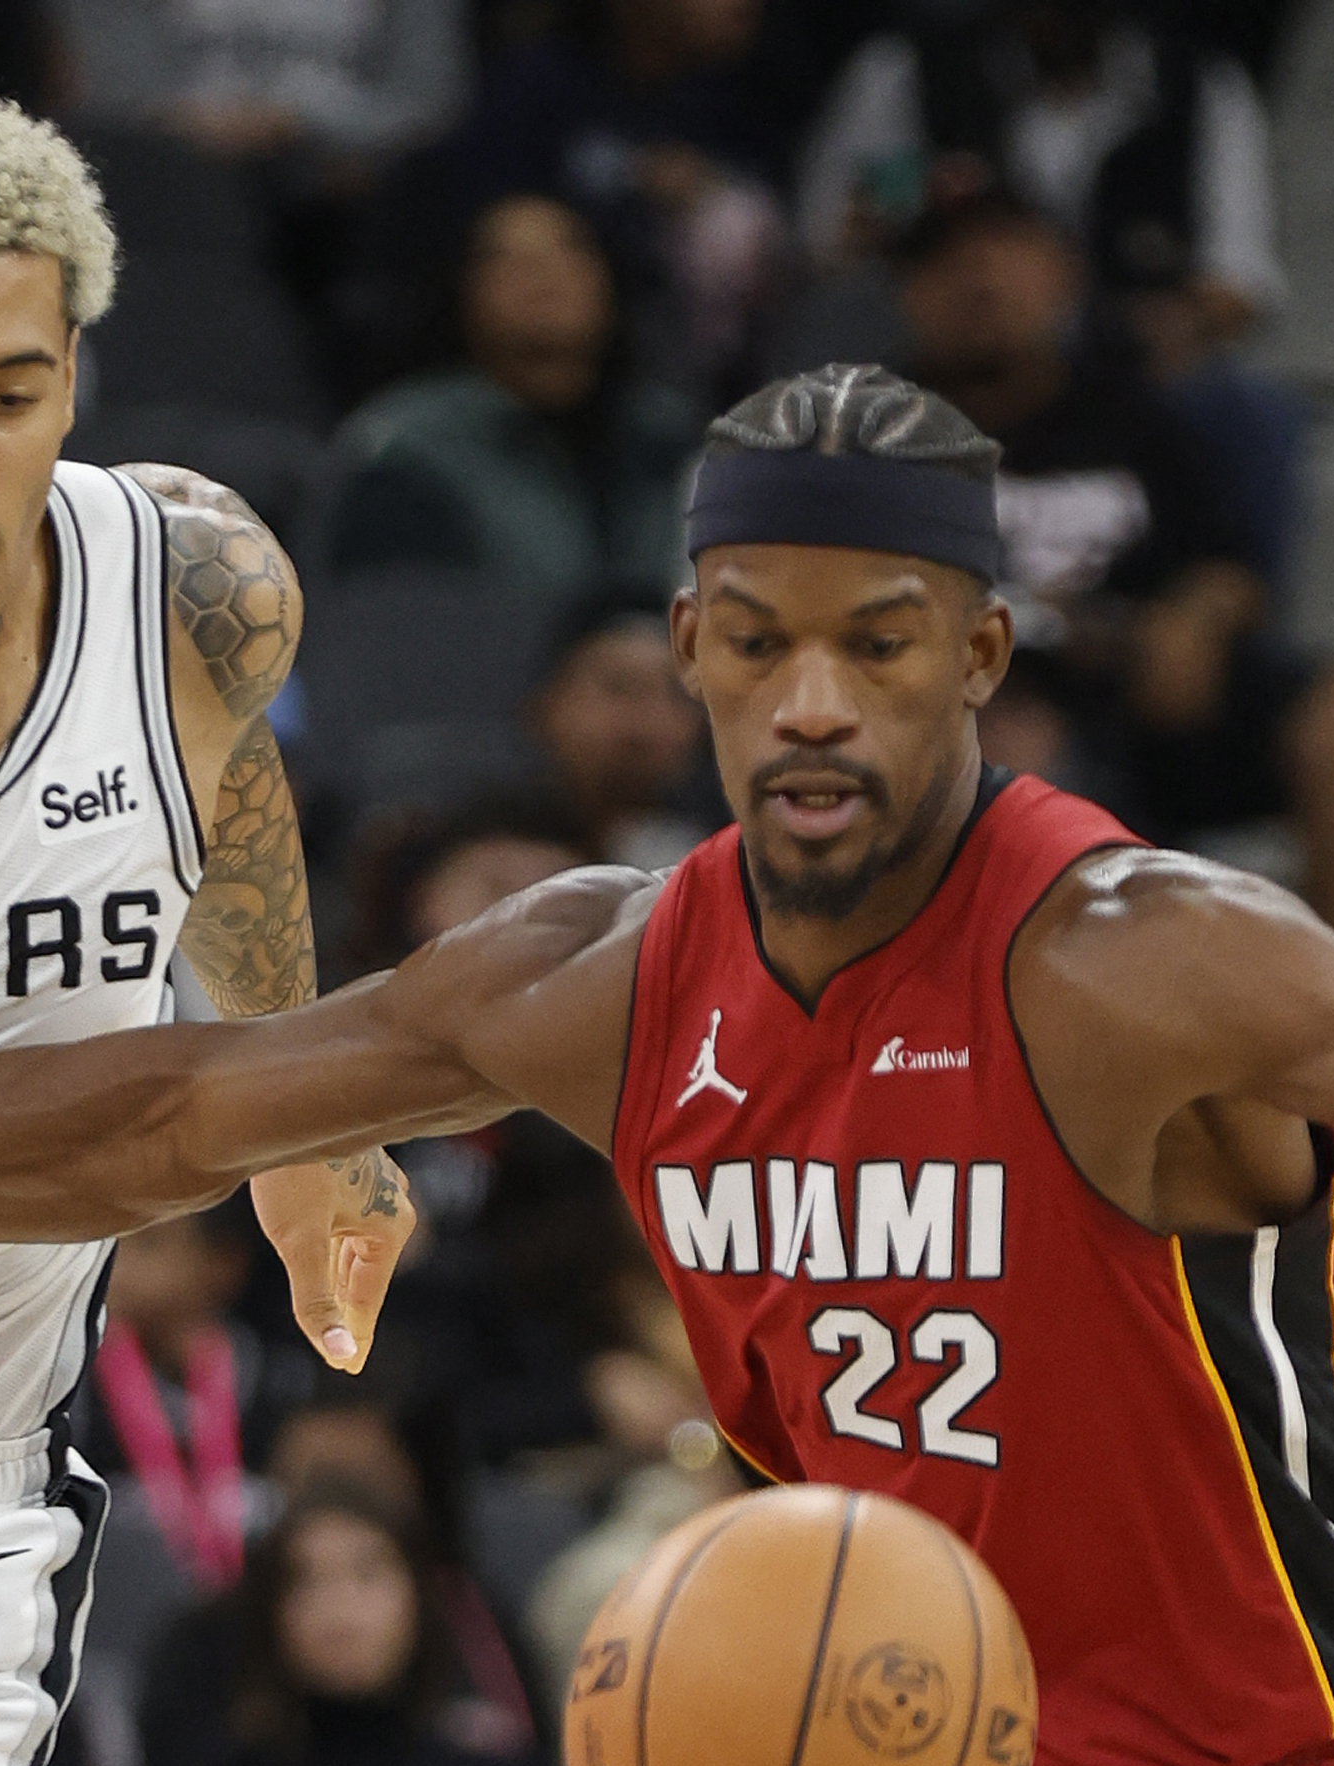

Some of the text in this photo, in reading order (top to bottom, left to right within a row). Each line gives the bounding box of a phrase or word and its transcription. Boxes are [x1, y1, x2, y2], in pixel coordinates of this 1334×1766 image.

[41, 765, 138, 830] Self.
[897, 1045, 970, 1070] Carnival
[653, 1157, 1006, 1282] MIAMI
[805, 1304, 1001, 1469] 22
